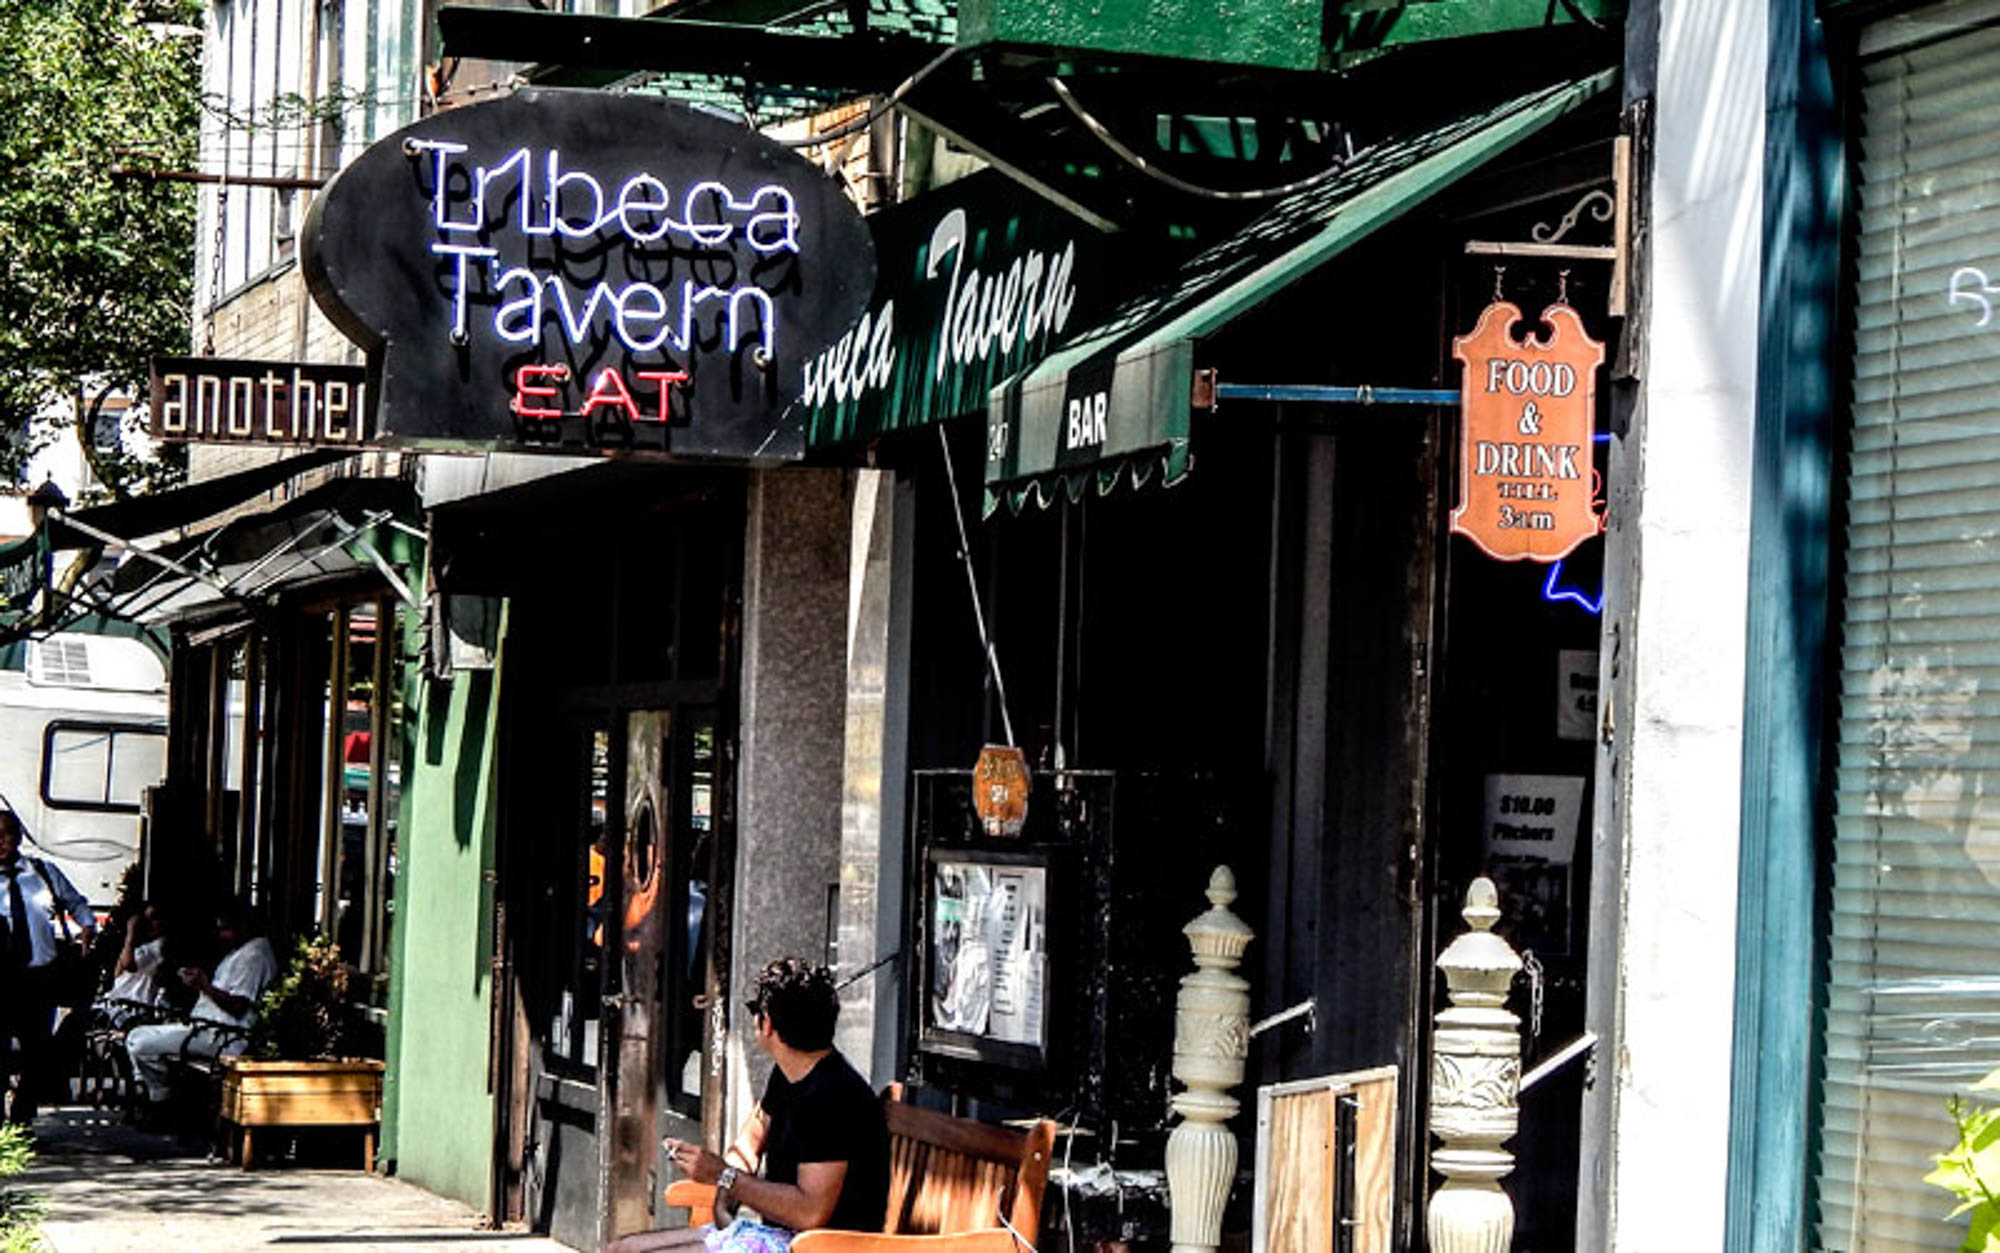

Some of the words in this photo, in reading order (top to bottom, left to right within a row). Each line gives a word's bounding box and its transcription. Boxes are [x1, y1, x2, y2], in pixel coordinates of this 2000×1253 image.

[403, 140, 799, 253] Tribeca
[432, 243, 774, 361] Tavern
[926, 207, 1076, 382] Tavern
[511, 365, 690, 423] EAT
[1486, 359, 1576, 397] FOOD
[1066, 391, 1108, 451] BAR
[1517, 402, 1542, 436] &
[1474, 440, 1580, 479] DRINK
[1497, 482, 1558, 501] TILL
[1498, 506, 1555, 531] 3am
[1500, 795, 1555, 815] $10.00
